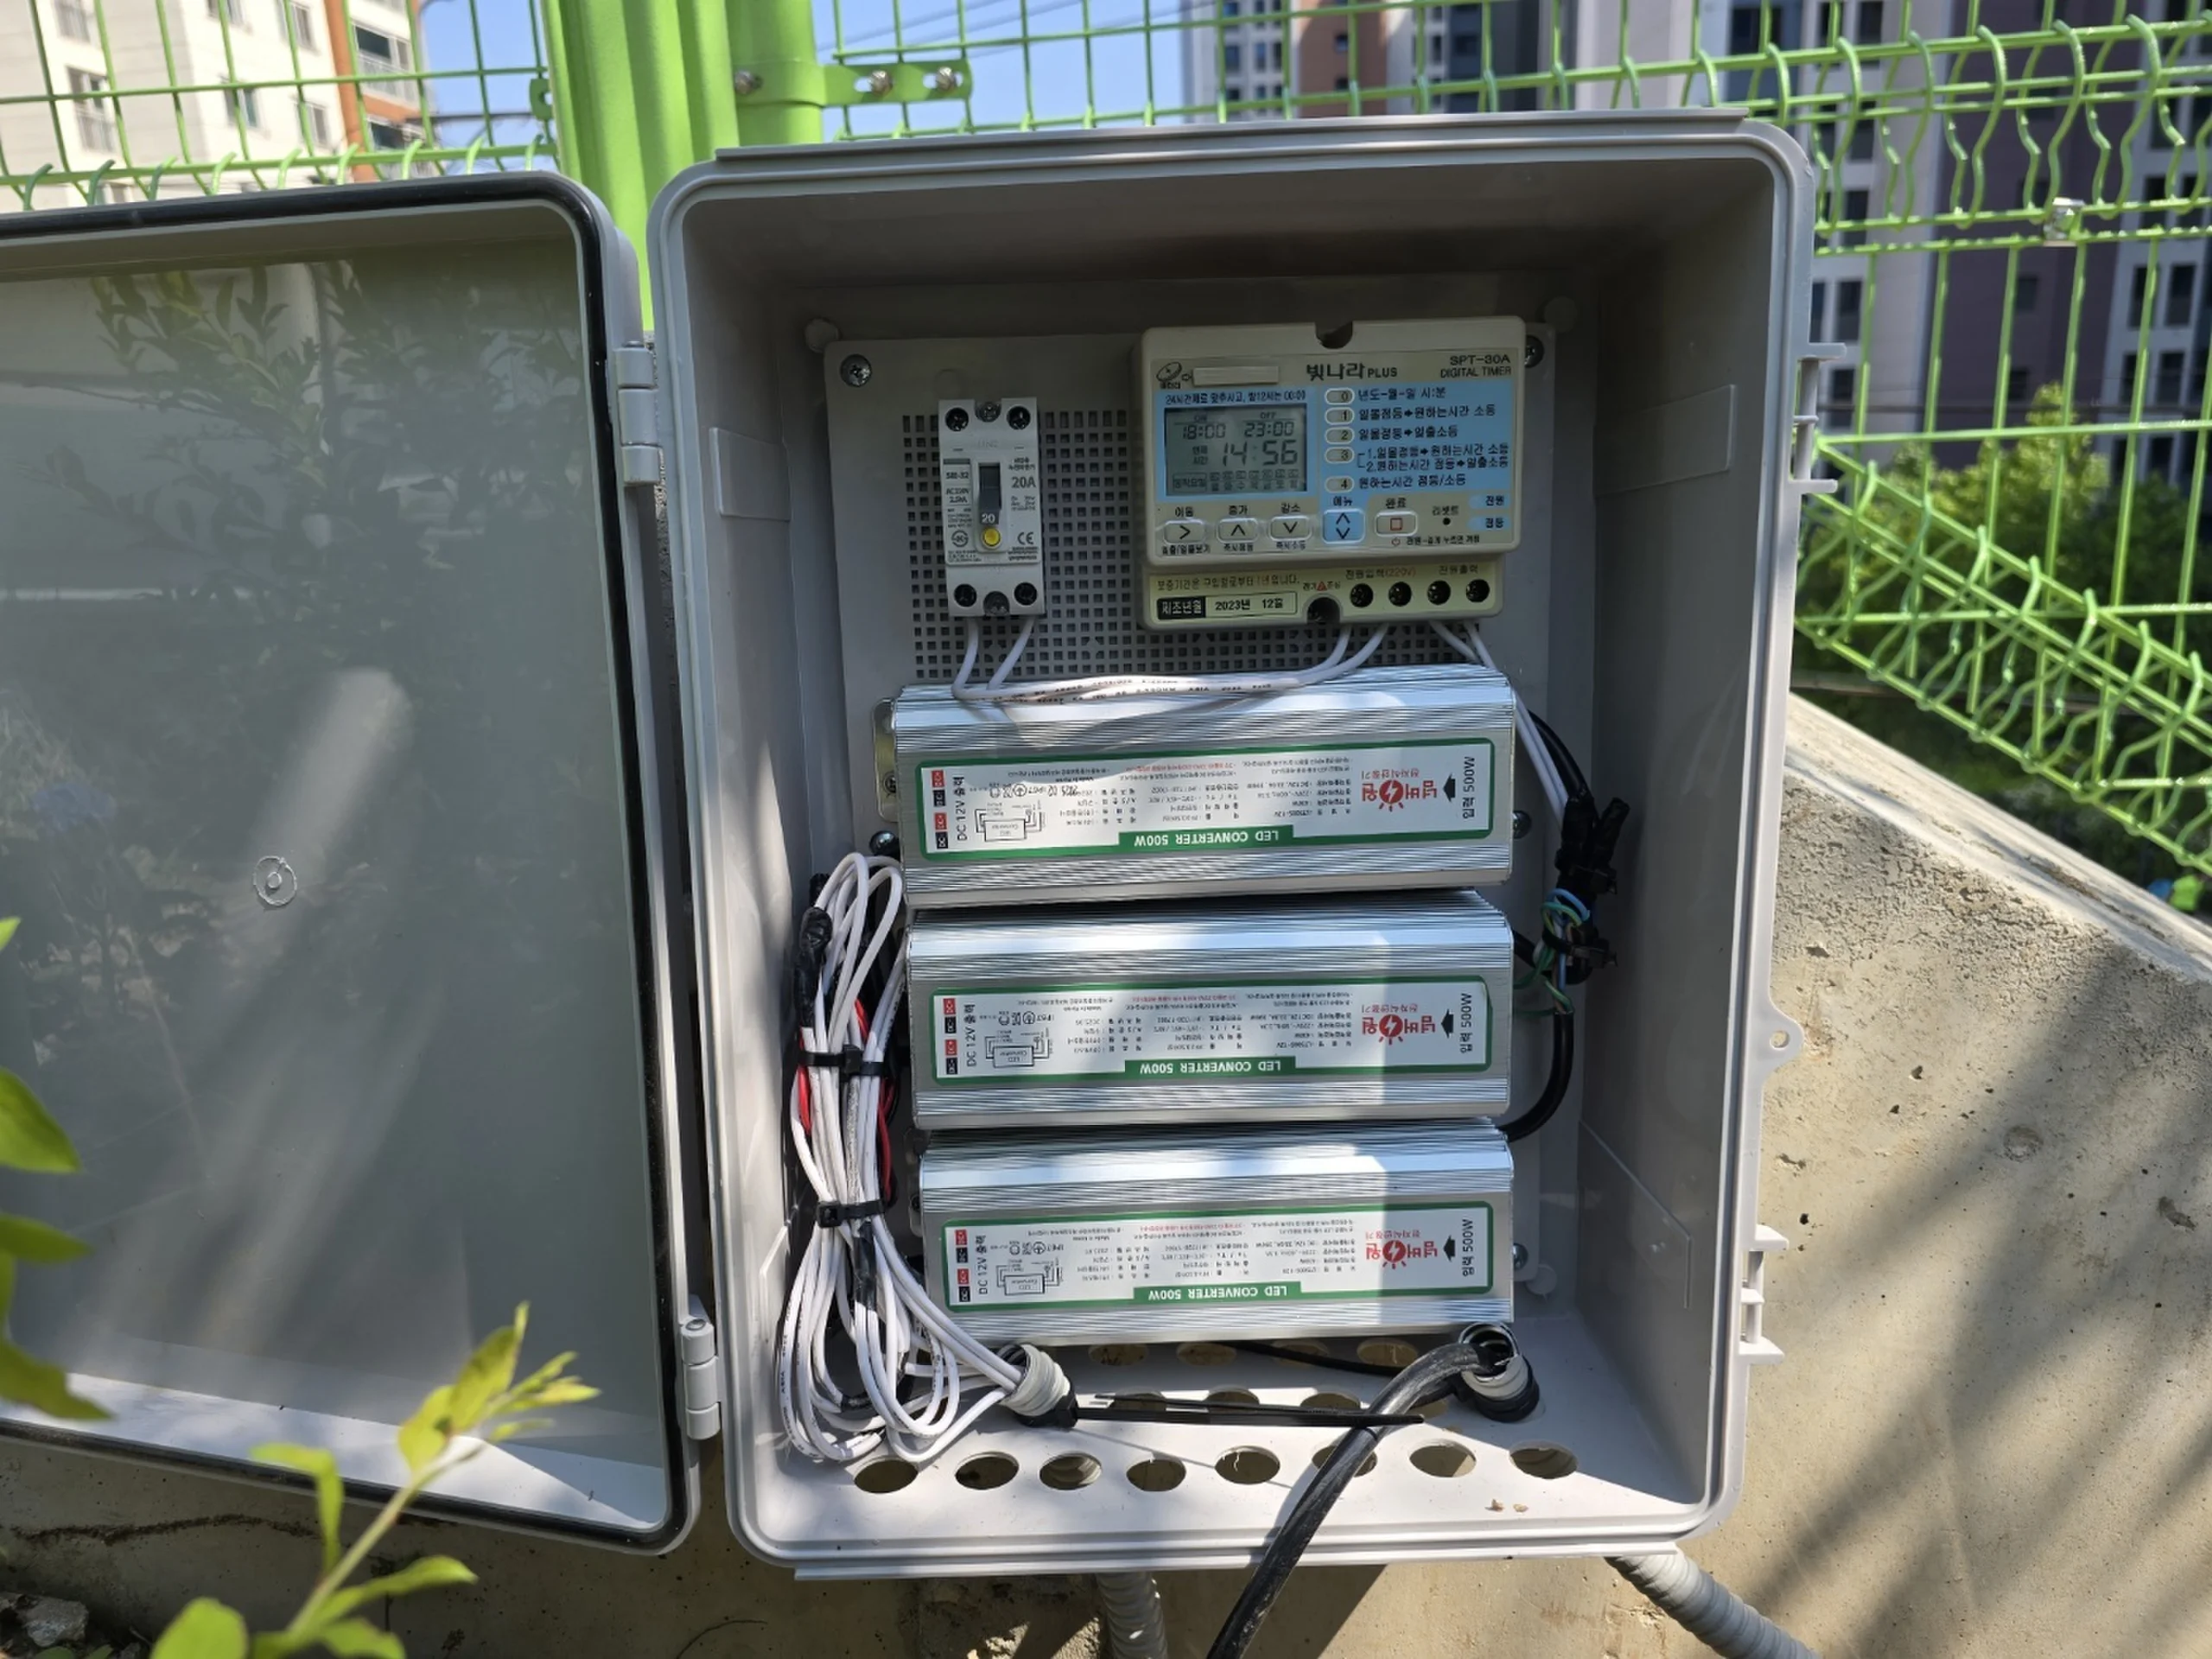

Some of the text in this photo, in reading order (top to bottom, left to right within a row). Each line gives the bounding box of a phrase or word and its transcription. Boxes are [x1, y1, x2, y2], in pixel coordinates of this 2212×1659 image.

[1450, 355, 1510, 365] SPT-30A
[1368, 367, 1397, 378] PLUS
[1440, 365, 1511, 378] DIGITAL TIMER
[1340, 391, 1349, 401] 0
[1183, 423, 1227, 440] 18:00
[1244, 421, 1294, 438] 23:00
[1341, 429, 1349, 440] 2
[1223, 440, 1299, 467] 14:56
[1341, 449, 1349, 460] 3
[1011, 476, 1037, 489] 20A
[982, 513, 996, 524] 20
[1017, 532, 1034, 544] CE
[1215, 599, 1251, 611] 2023년
[1262, 598, 1283, 608] 12월
[1462, 756, 1475, 819] 500W 입력
[955, 800, 966, 821] 12V
[957, 824, 968, 841] DC
[1134, 830, 1279, 847] LED CONVERTER 500W
[1460, 993, 1473, 1054] 500W 입력
[964, 1027, 976, 1047] 12V
[966, 1051, 976, 1067] DC
[1139, 1059, 1281, 1074] LED CONVERTER 500W
[1461, 1217, 1475, 1278] 500W 입력
[976, 1256, 987, 1275] 12V
[977, 1280, 988, 1295] DC
[1147, 1285, 1287, 1301] LED CONVERTER 500W
